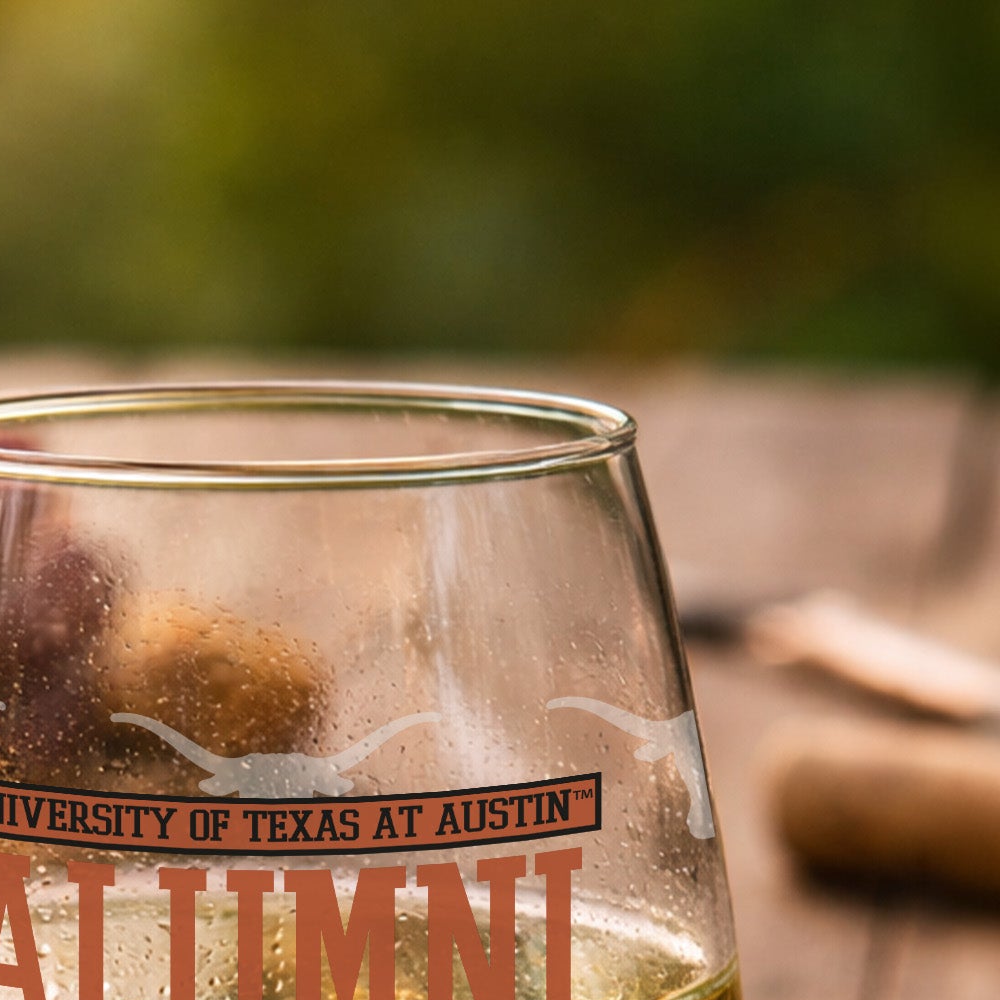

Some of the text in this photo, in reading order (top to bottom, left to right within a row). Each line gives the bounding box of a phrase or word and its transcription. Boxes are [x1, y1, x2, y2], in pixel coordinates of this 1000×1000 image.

[189, 809, 230, 842] OF
[242, 809, 360, 843] TEXAS
[372, 805, 423, 840] AT
